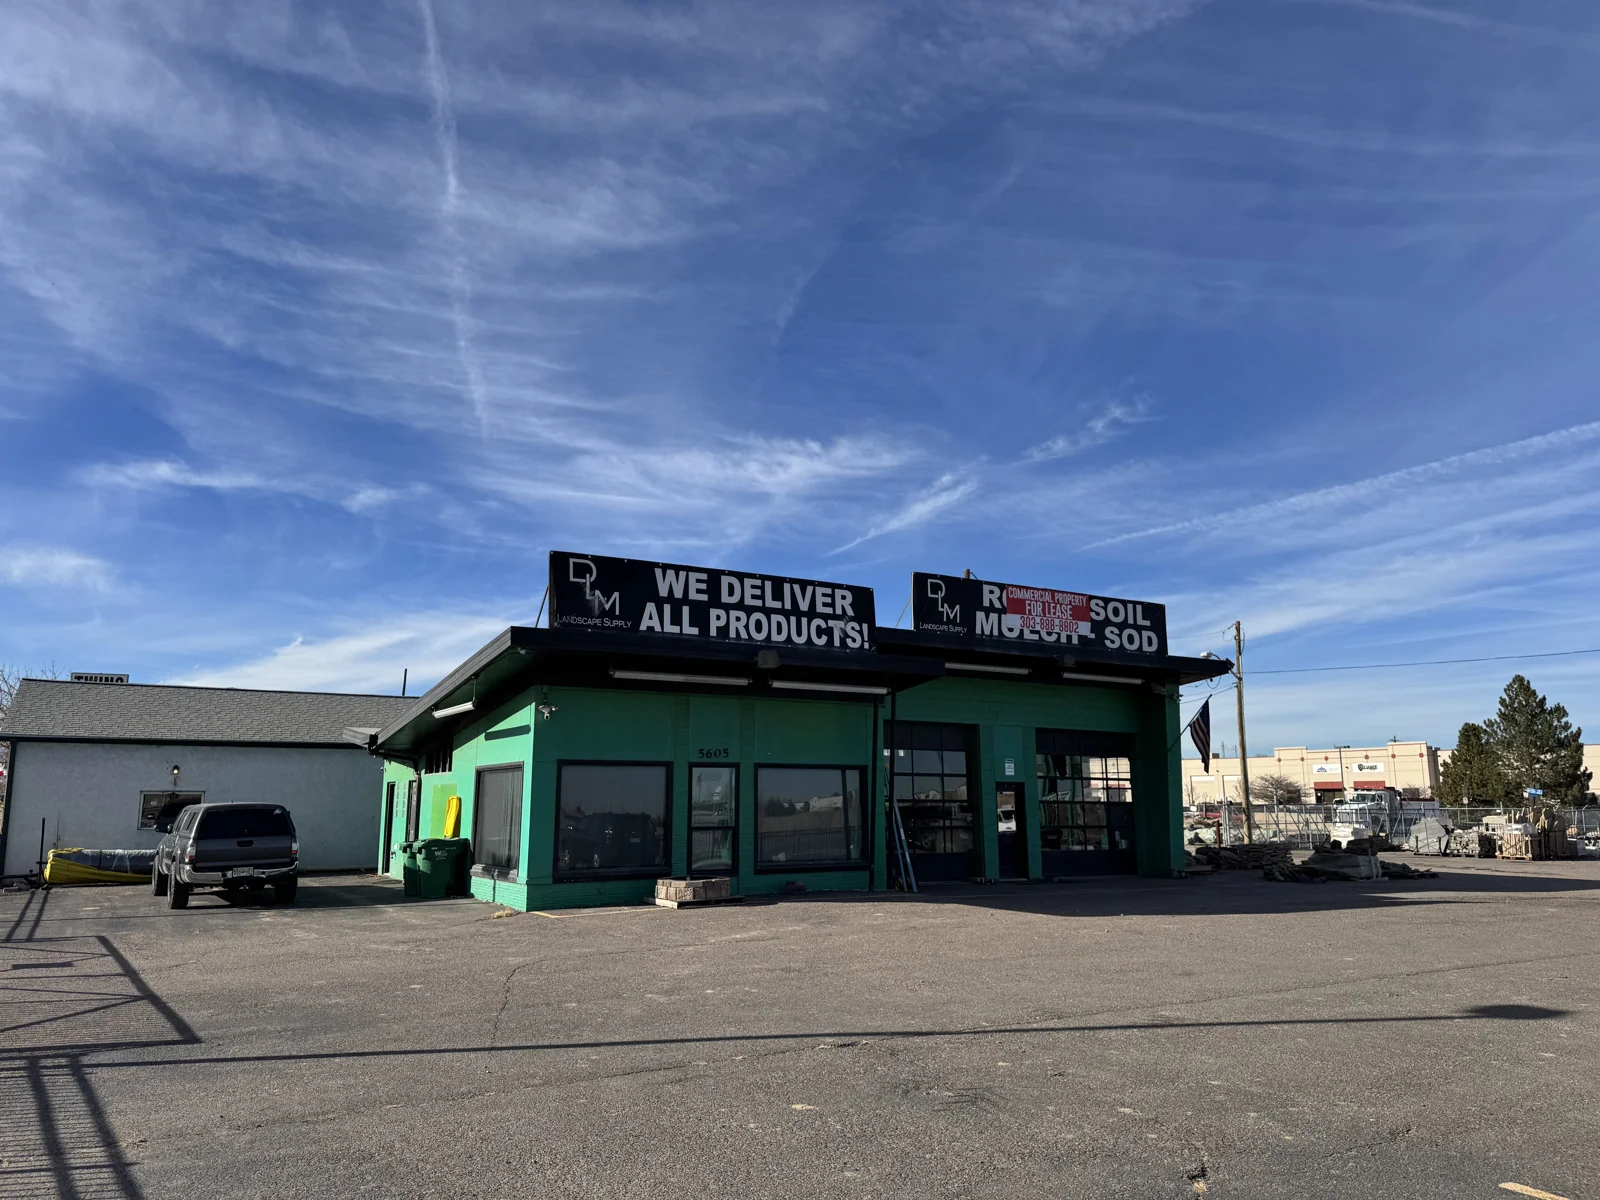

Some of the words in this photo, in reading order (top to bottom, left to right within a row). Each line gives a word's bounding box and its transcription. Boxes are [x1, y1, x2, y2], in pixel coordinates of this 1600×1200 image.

[654, 568, 708, 601] WE
[720, 575, 855, 616] DELIVER
[1008, 586, 1053, 603] COMMERCIAL
[1054, 592, 1088, 607] PROPERTY
[1025, 601, 1043, 616] FOR
[1045, 603, 1073, 620] LEASE
[556, 613, 602, 626] LANDSCAPE
[603, 617, 632, 629] SUPPLY
[639, 601, 699, 635] ALL
[709, 608, 869, 650] PRODUCTS!
[919, 621, 949, 632] LANDSCAPE
[948, 624, 968, 634] SUPPLY
[1020, 615, 1080, 634] 303-888-8802
[1104, 626, 1159, 653] SOD
[698, 747, 729, 759] 5605
